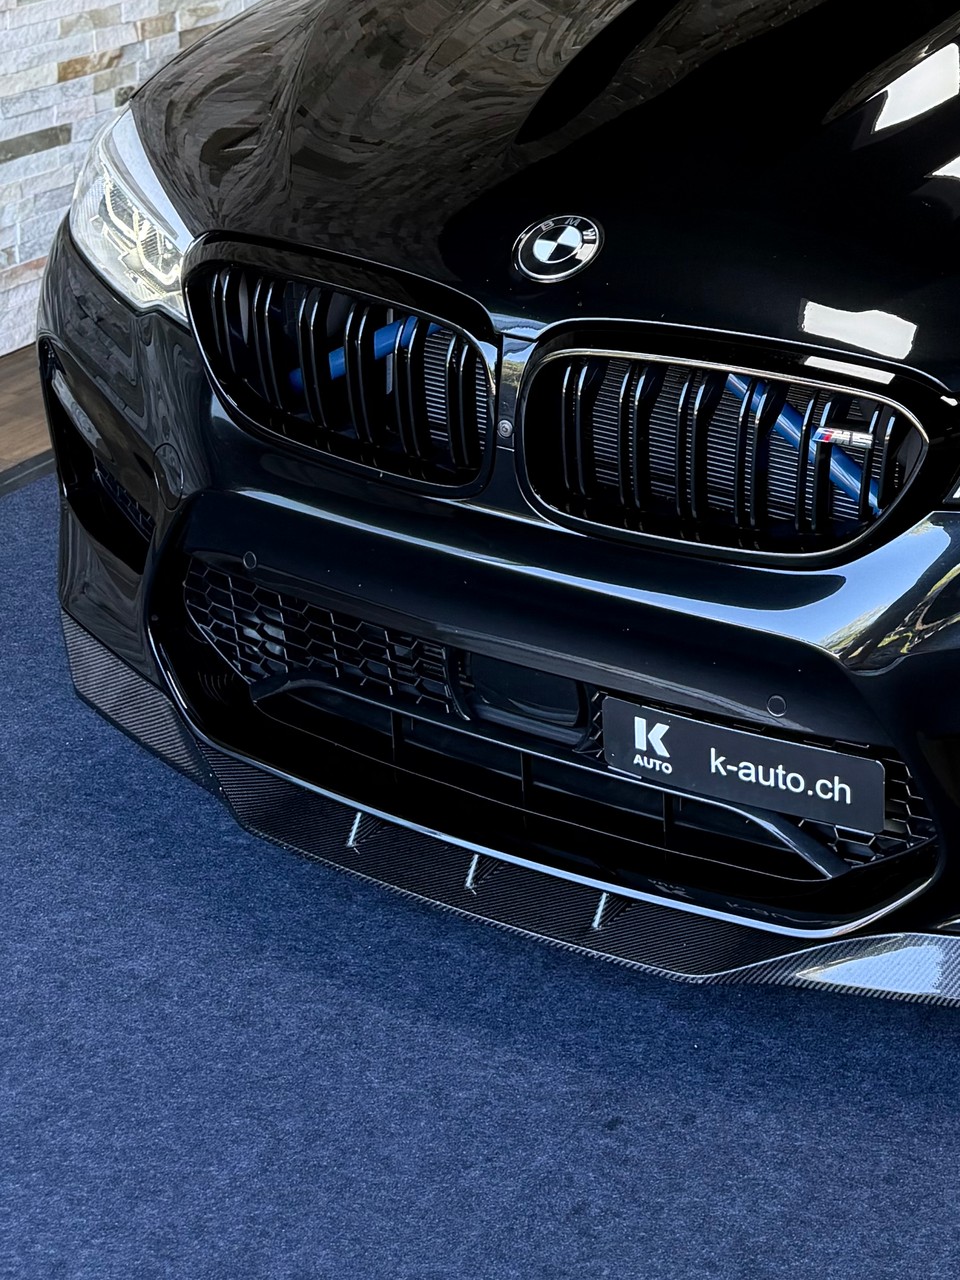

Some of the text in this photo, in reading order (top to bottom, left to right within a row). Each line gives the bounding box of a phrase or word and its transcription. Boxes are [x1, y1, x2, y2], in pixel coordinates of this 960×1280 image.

[829, 428, 873, 449] M5
[634, 716, 671, 758] K
[633, 754, 673, 775] AUTO
[709, 747, 852, 805] k-auto.ch
